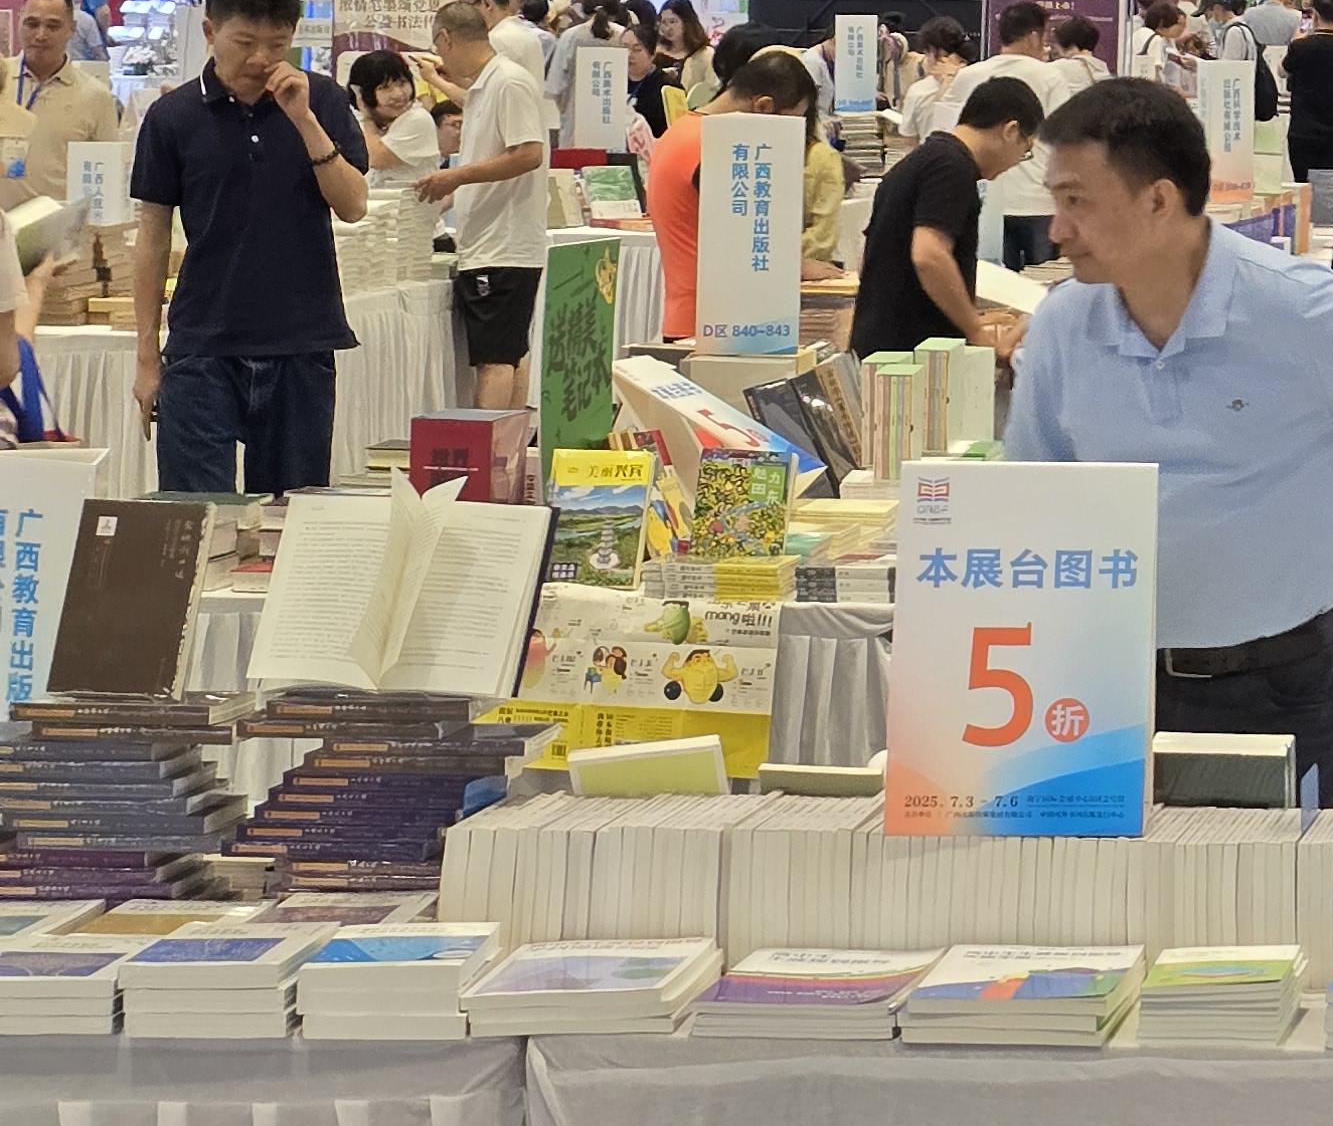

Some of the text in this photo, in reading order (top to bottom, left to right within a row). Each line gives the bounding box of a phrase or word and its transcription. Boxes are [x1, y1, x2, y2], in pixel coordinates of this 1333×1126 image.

[731, 143, 772, 272] 广西教育出版社 有限公司
[703, 324, 728, 338] D区
[751, 483, 780, 506] 田东
[6, 508, 44, 702] 广西教育出版
[916, 547, 1139, 589] 本展台图书
[961, 621, 1085, 748] 5 折
